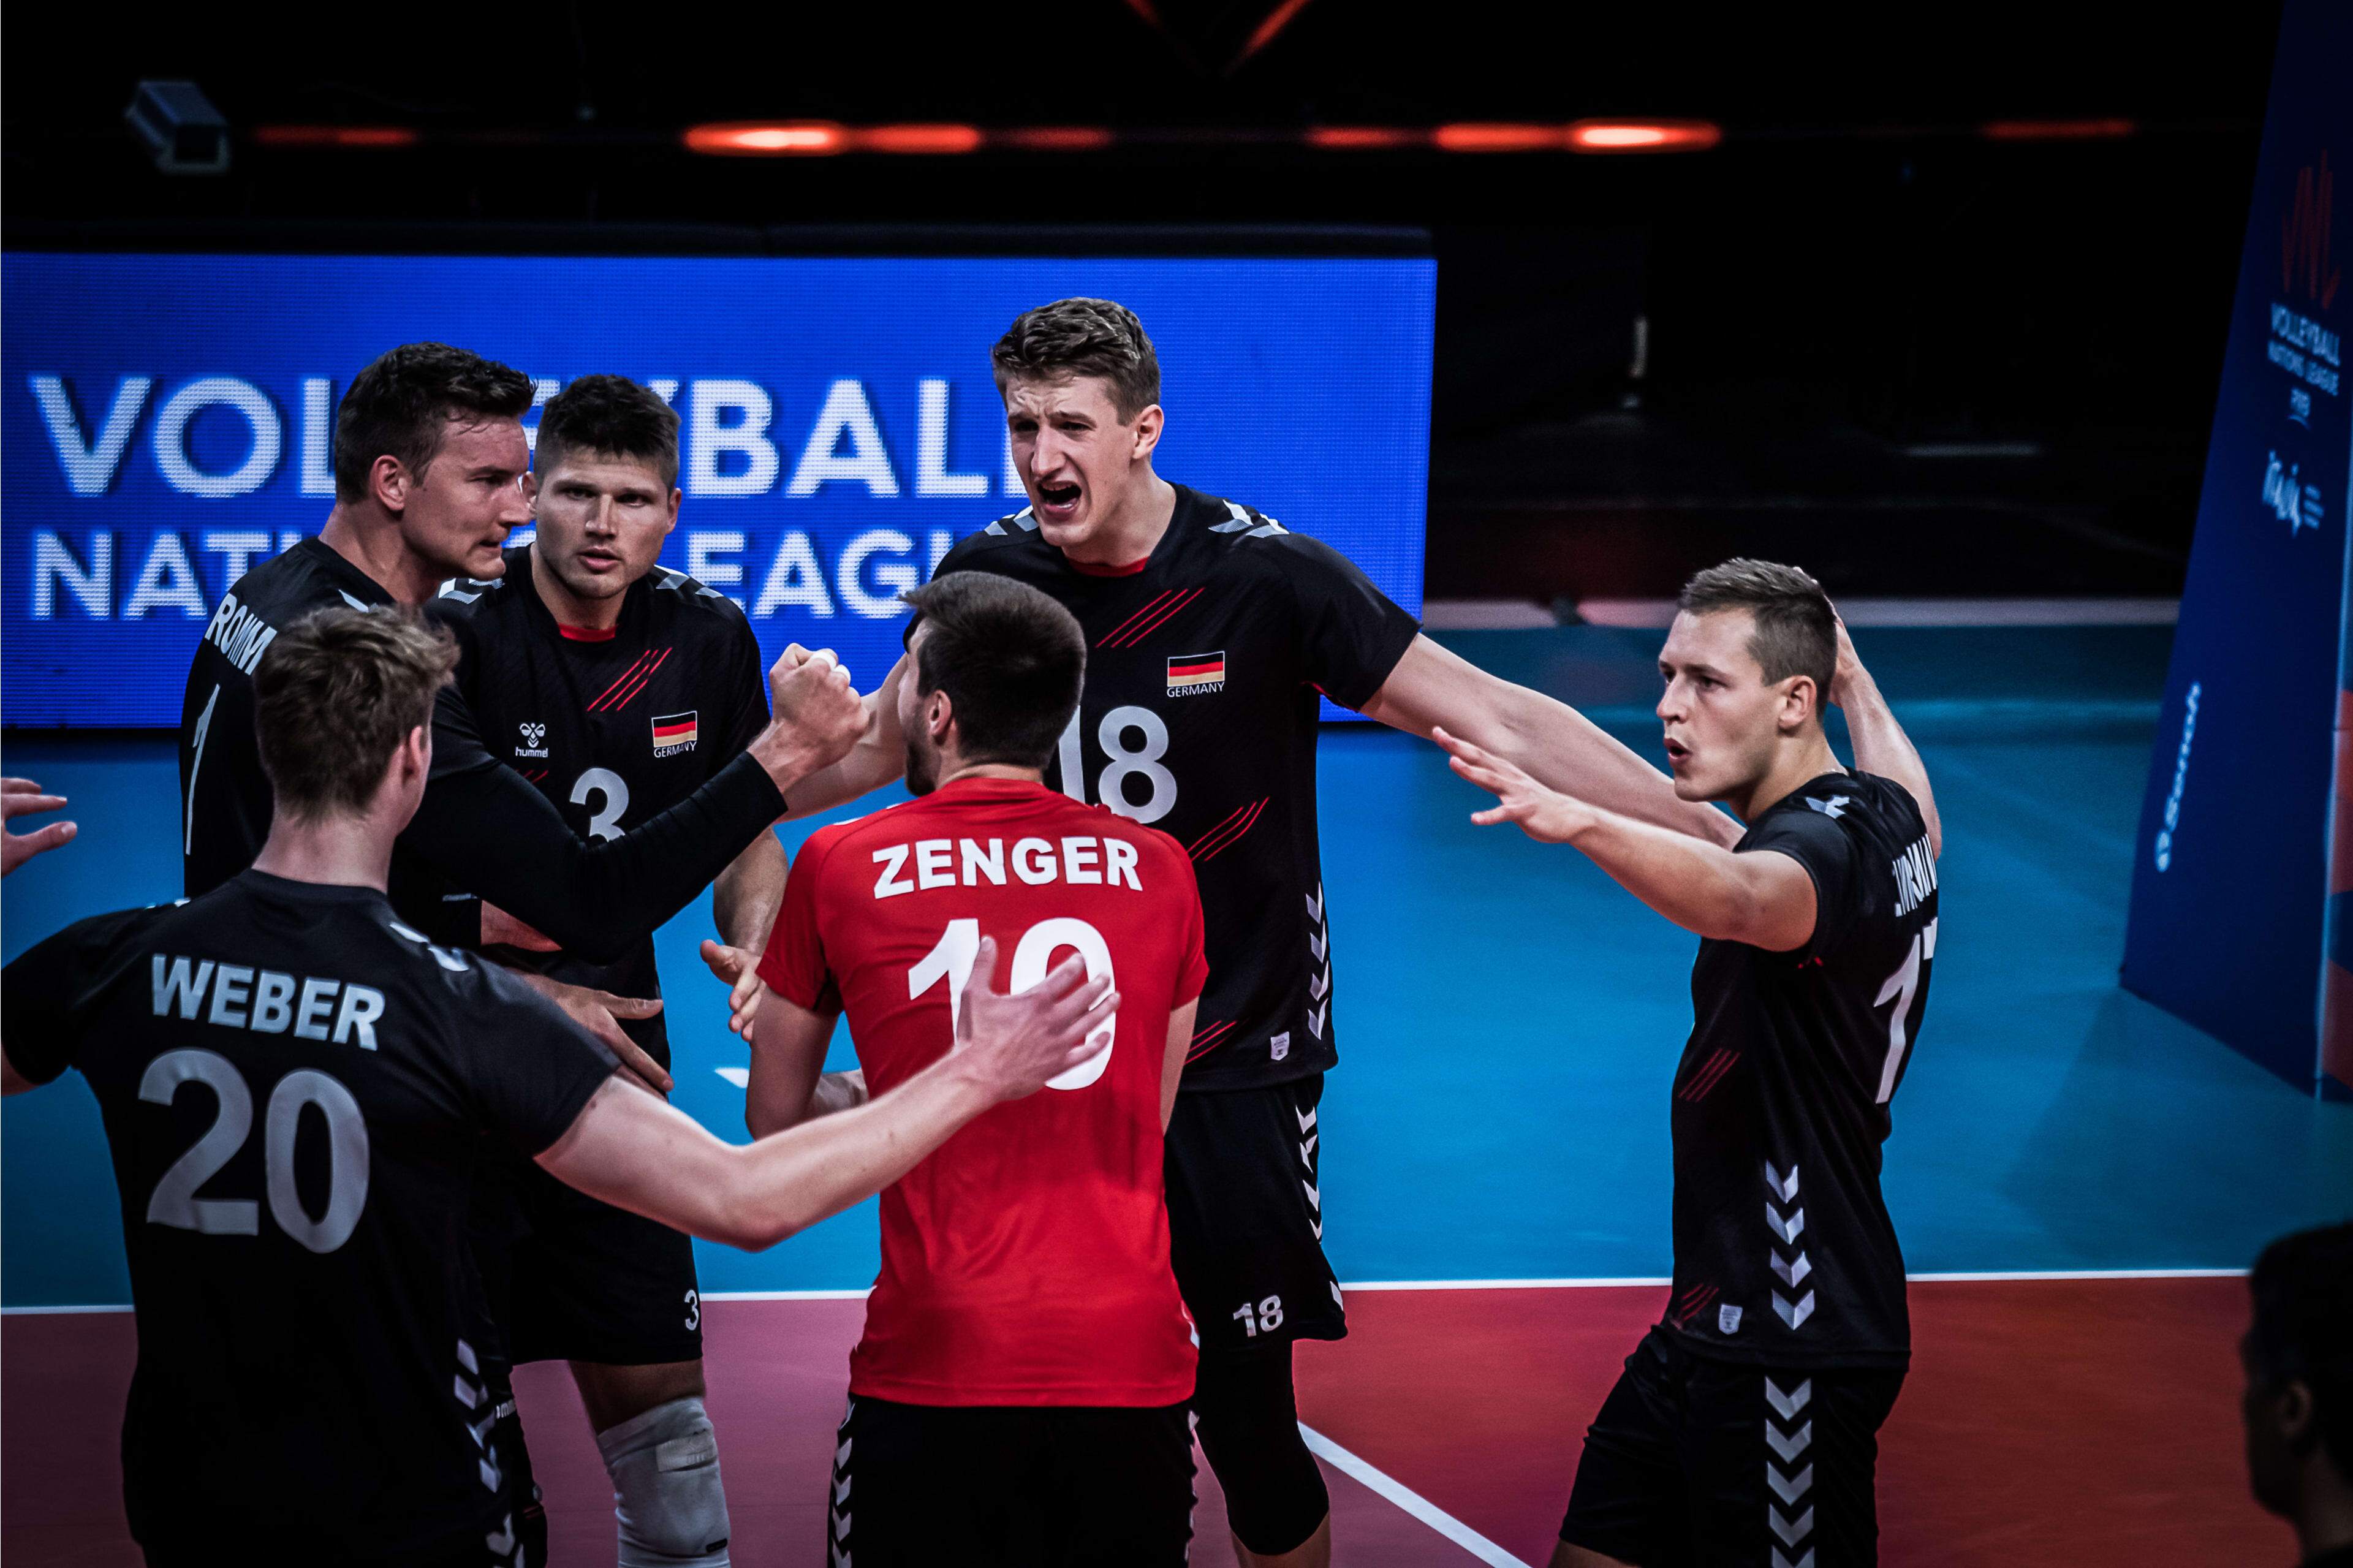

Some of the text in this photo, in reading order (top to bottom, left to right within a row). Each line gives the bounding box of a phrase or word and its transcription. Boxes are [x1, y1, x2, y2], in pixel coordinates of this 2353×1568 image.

[28, 375, 1036, 498] VOLBAL
[1167, 681, 1225, 698] GERMANY
[515, 746, 548, 758] hummel
[654, 741, 697, 758] GERMANY
[1058, 705, 1178, 824] 18
[569, 767, 629, 843] 3
[873, 836, 1143, 900] ZENGER
[151, 953, 385, 1051] WEBER
[138, 1047, 369, 1254] 20
[684, 1289, 699, 1331] 3
[1233, 1294, 1283, 1338] 18
